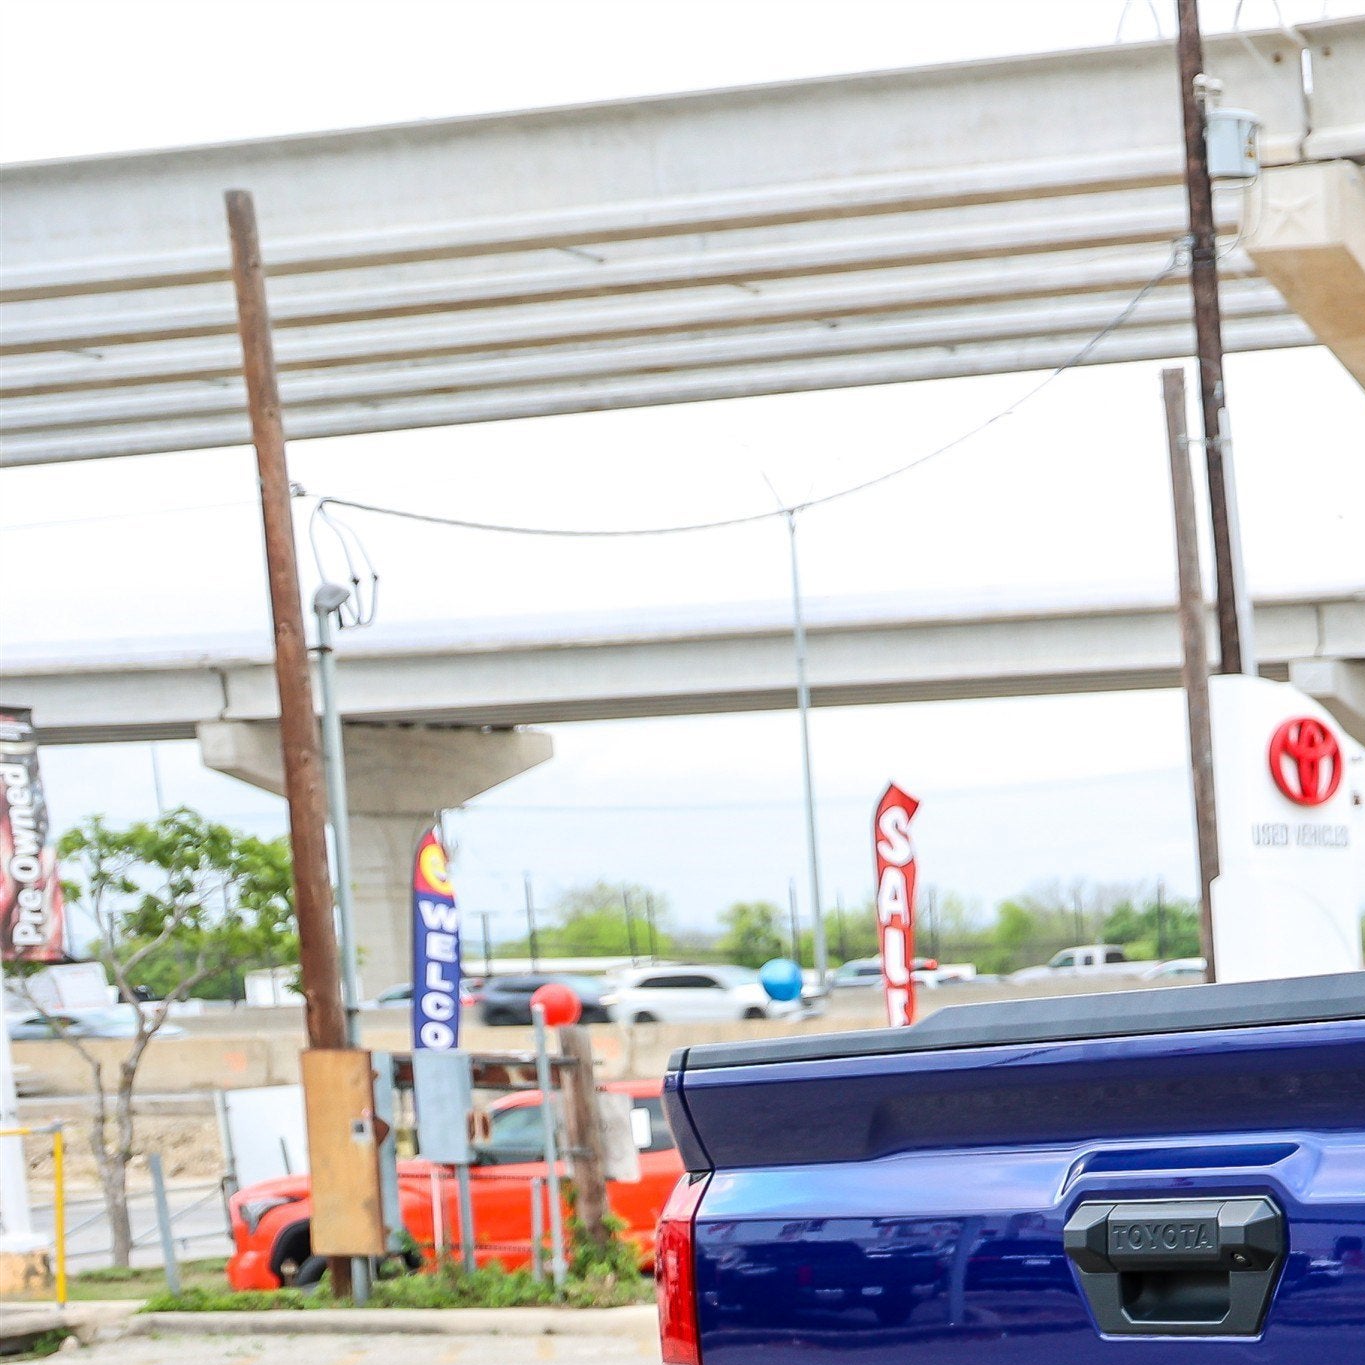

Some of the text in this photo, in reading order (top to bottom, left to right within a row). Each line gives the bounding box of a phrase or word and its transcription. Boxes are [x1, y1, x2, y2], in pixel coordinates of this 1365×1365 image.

[0, 762, 42, 884] Owned
[877, 805, 914, 1027] SALE
[1112, 1222, 1214, 1250] TOYOTA
